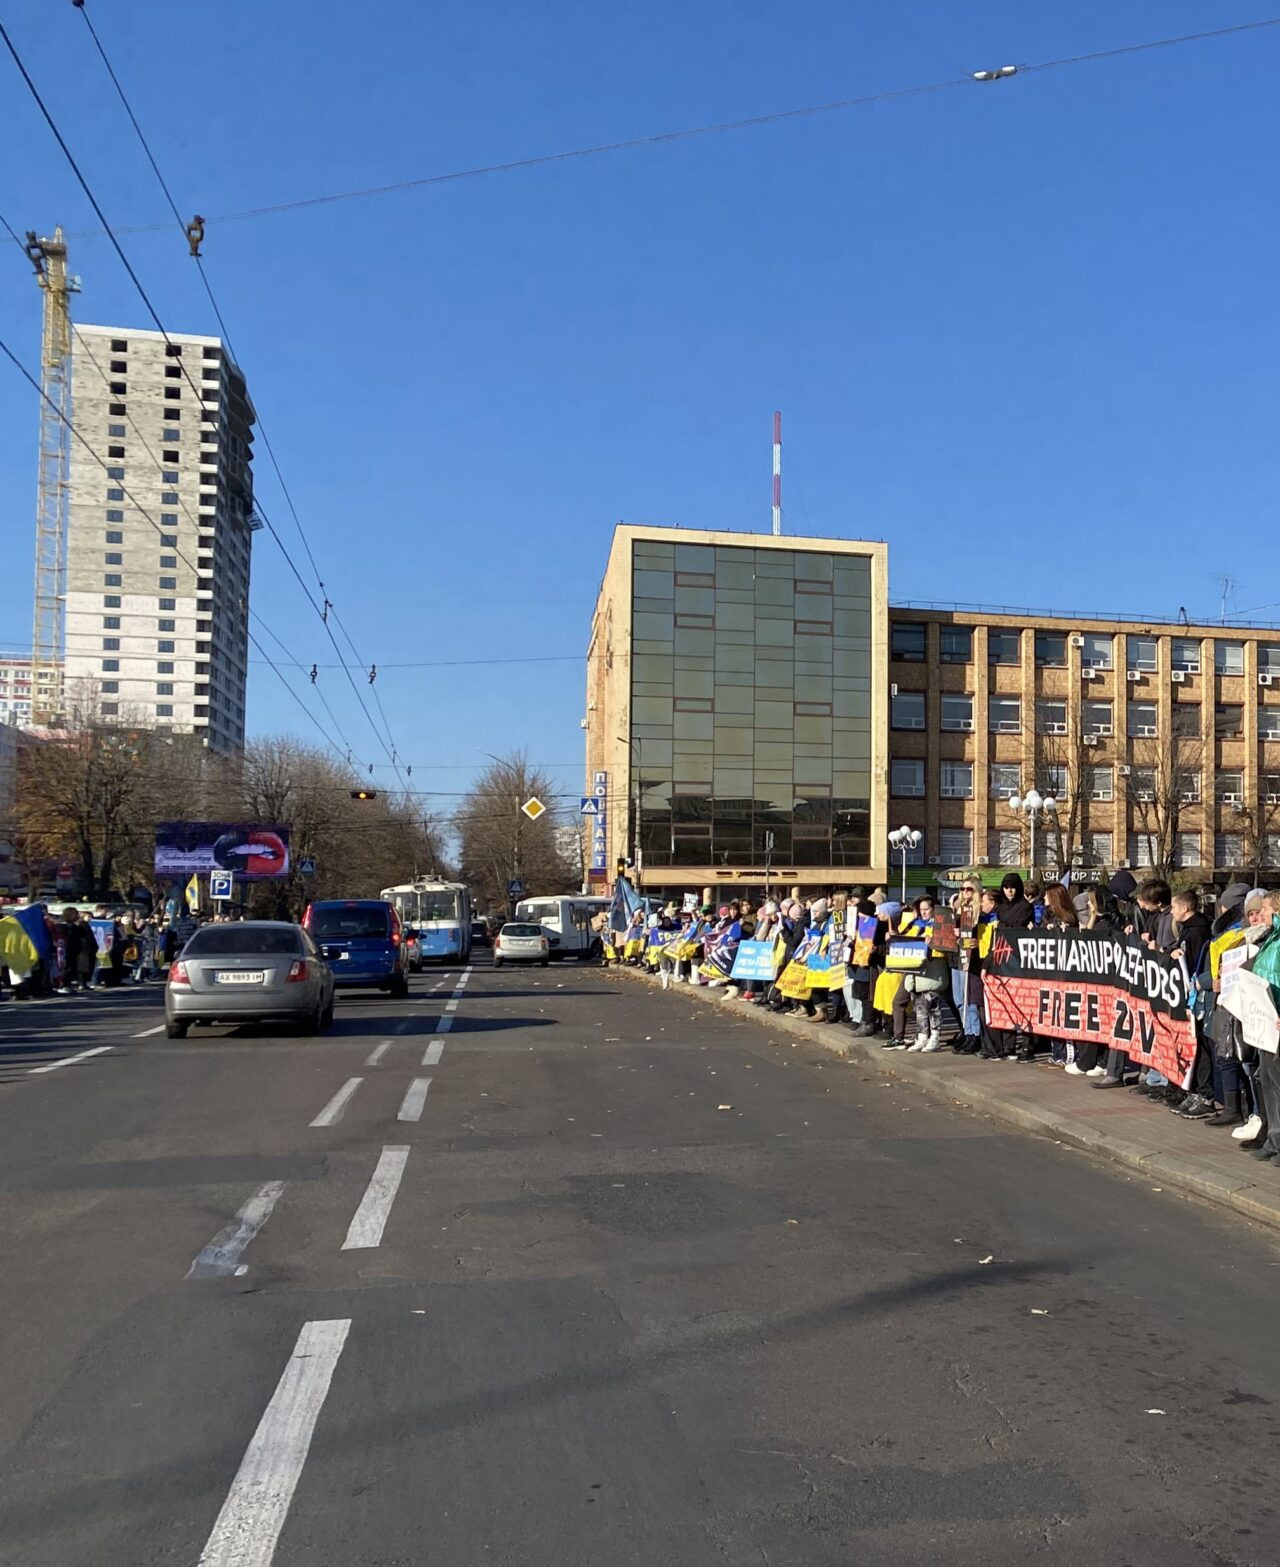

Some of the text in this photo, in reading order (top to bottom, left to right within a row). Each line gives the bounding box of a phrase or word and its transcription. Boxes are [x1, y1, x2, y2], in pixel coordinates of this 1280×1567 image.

[212, 871, 232, 879] ЗОНА
[1017, 937, 1055, 969] FREE
[1037, 988, 1101, 1032] FREE
